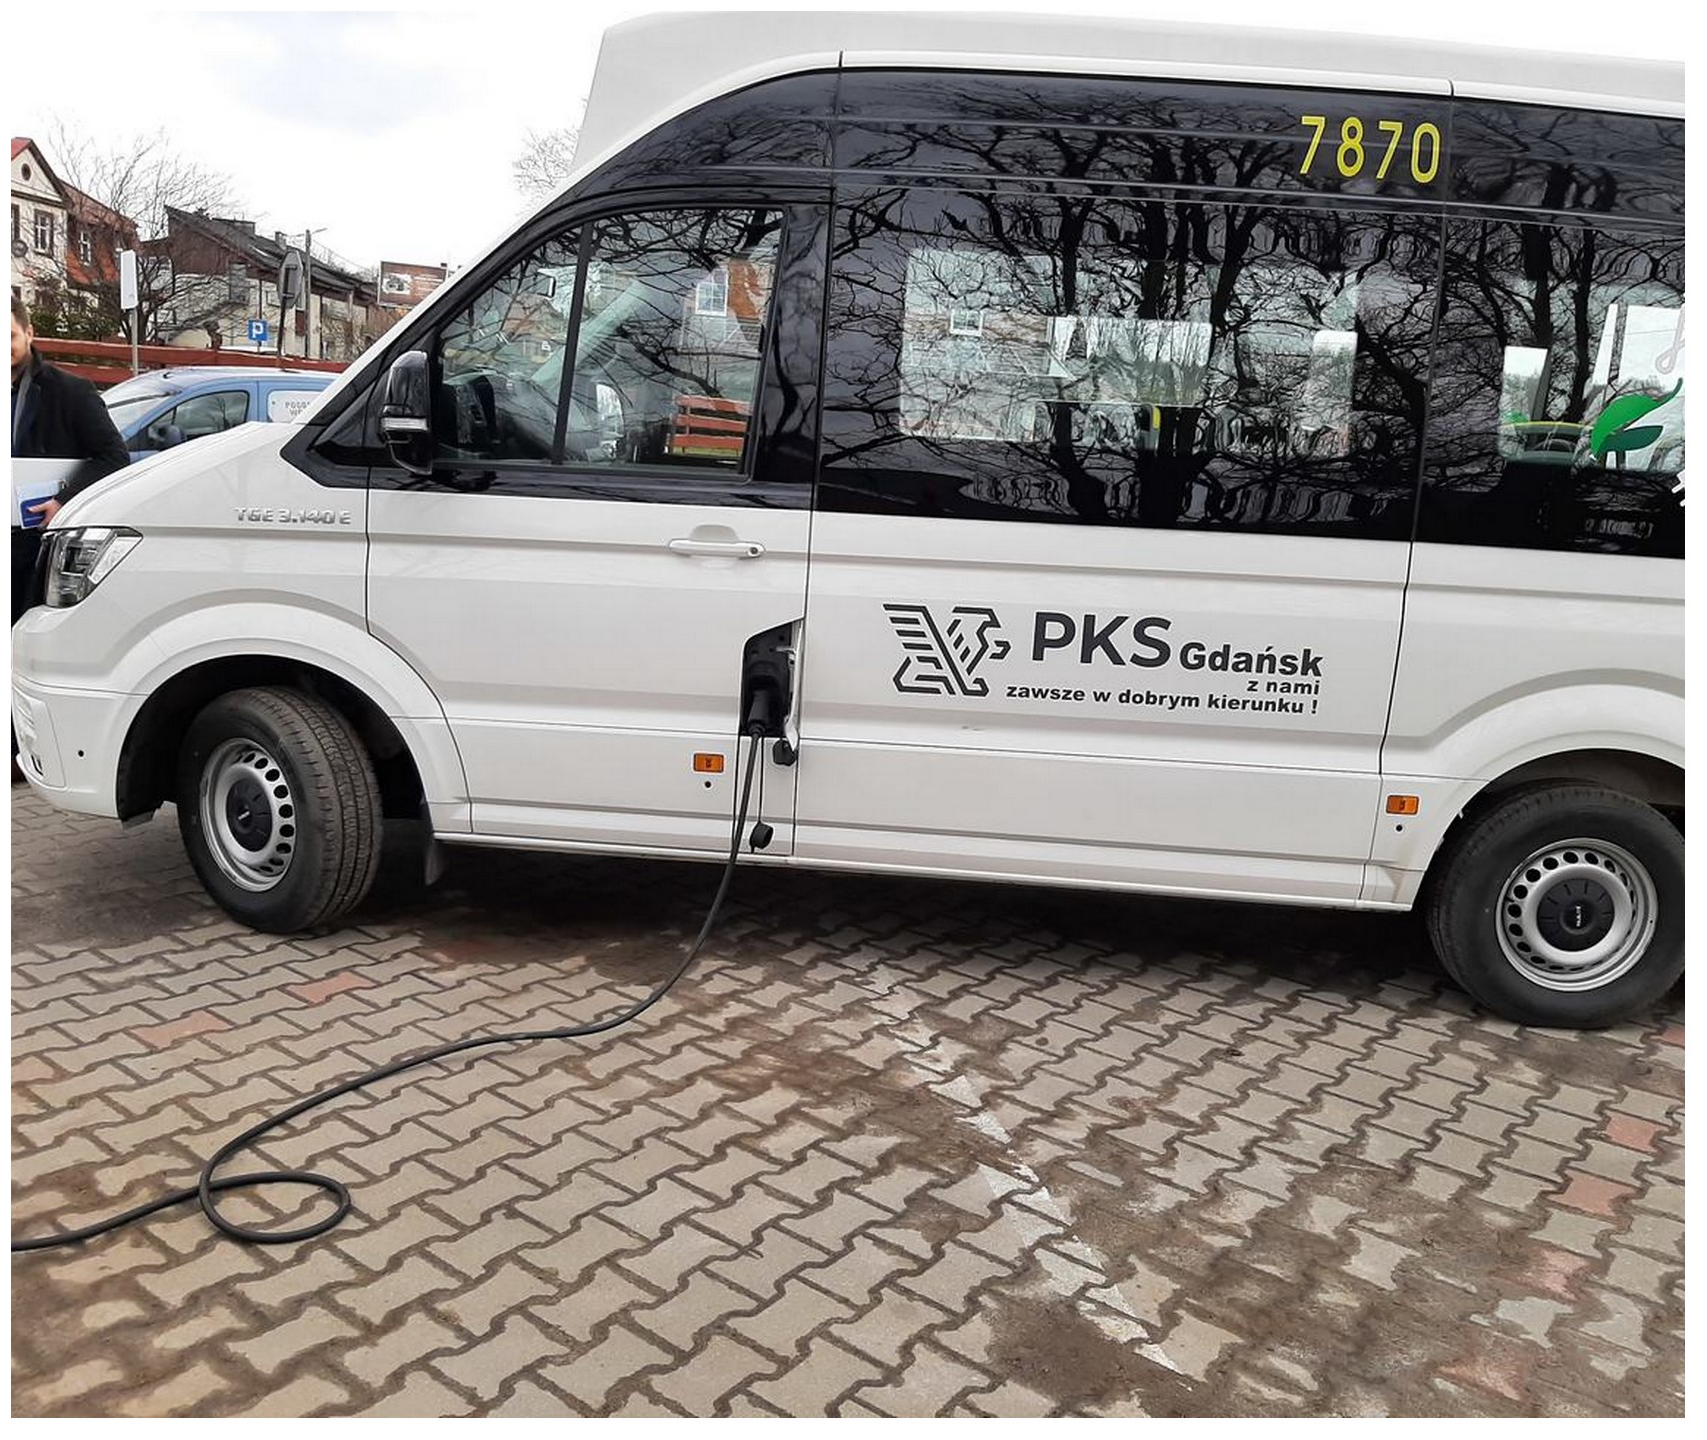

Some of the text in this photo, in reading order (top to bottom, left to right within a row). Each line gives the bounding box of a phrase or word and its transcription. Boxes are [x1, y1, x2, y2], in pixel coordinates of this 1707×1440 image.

[1299, 114, 1442, 184] 7870
[251, 322, 265, 339] P
[1031, 611, 1324, 677] PKS Gdańsk
[1005, 685, 1319, 715] zawsze w dobrym kierunku !
[1246, 679, 1321, 695] z nami
